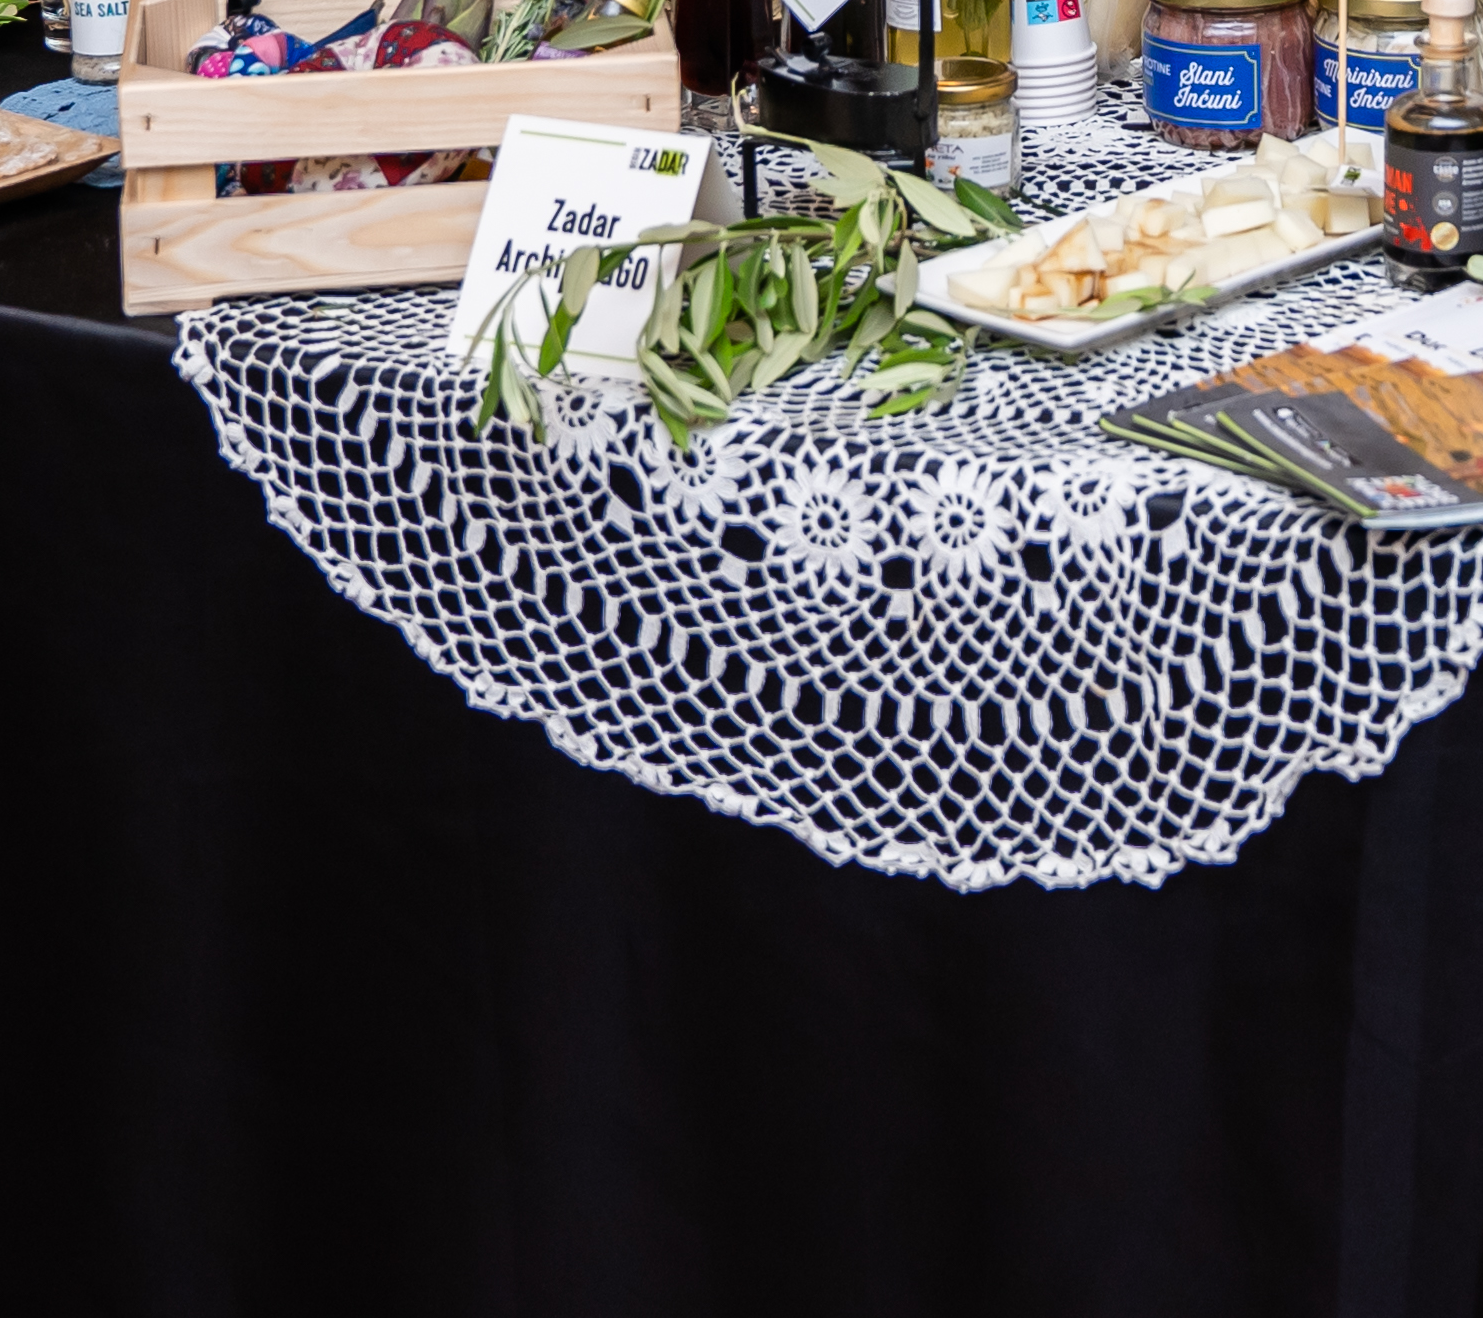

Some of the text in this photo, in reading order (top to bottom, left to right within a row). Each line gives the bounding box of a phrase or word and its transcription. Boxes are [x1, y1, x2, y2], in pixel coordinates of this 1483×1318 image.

[74, 0, 129, 17] SEA SALT
[1180, 62, 1235, 87] Slani
[1323, 58, 1414, 89] Mrinirani
[1174, 86, 1243, 110] Inćuni
[1350, 87, 1392, 109] Inću
[547, 199, 622, 240] Zadar
